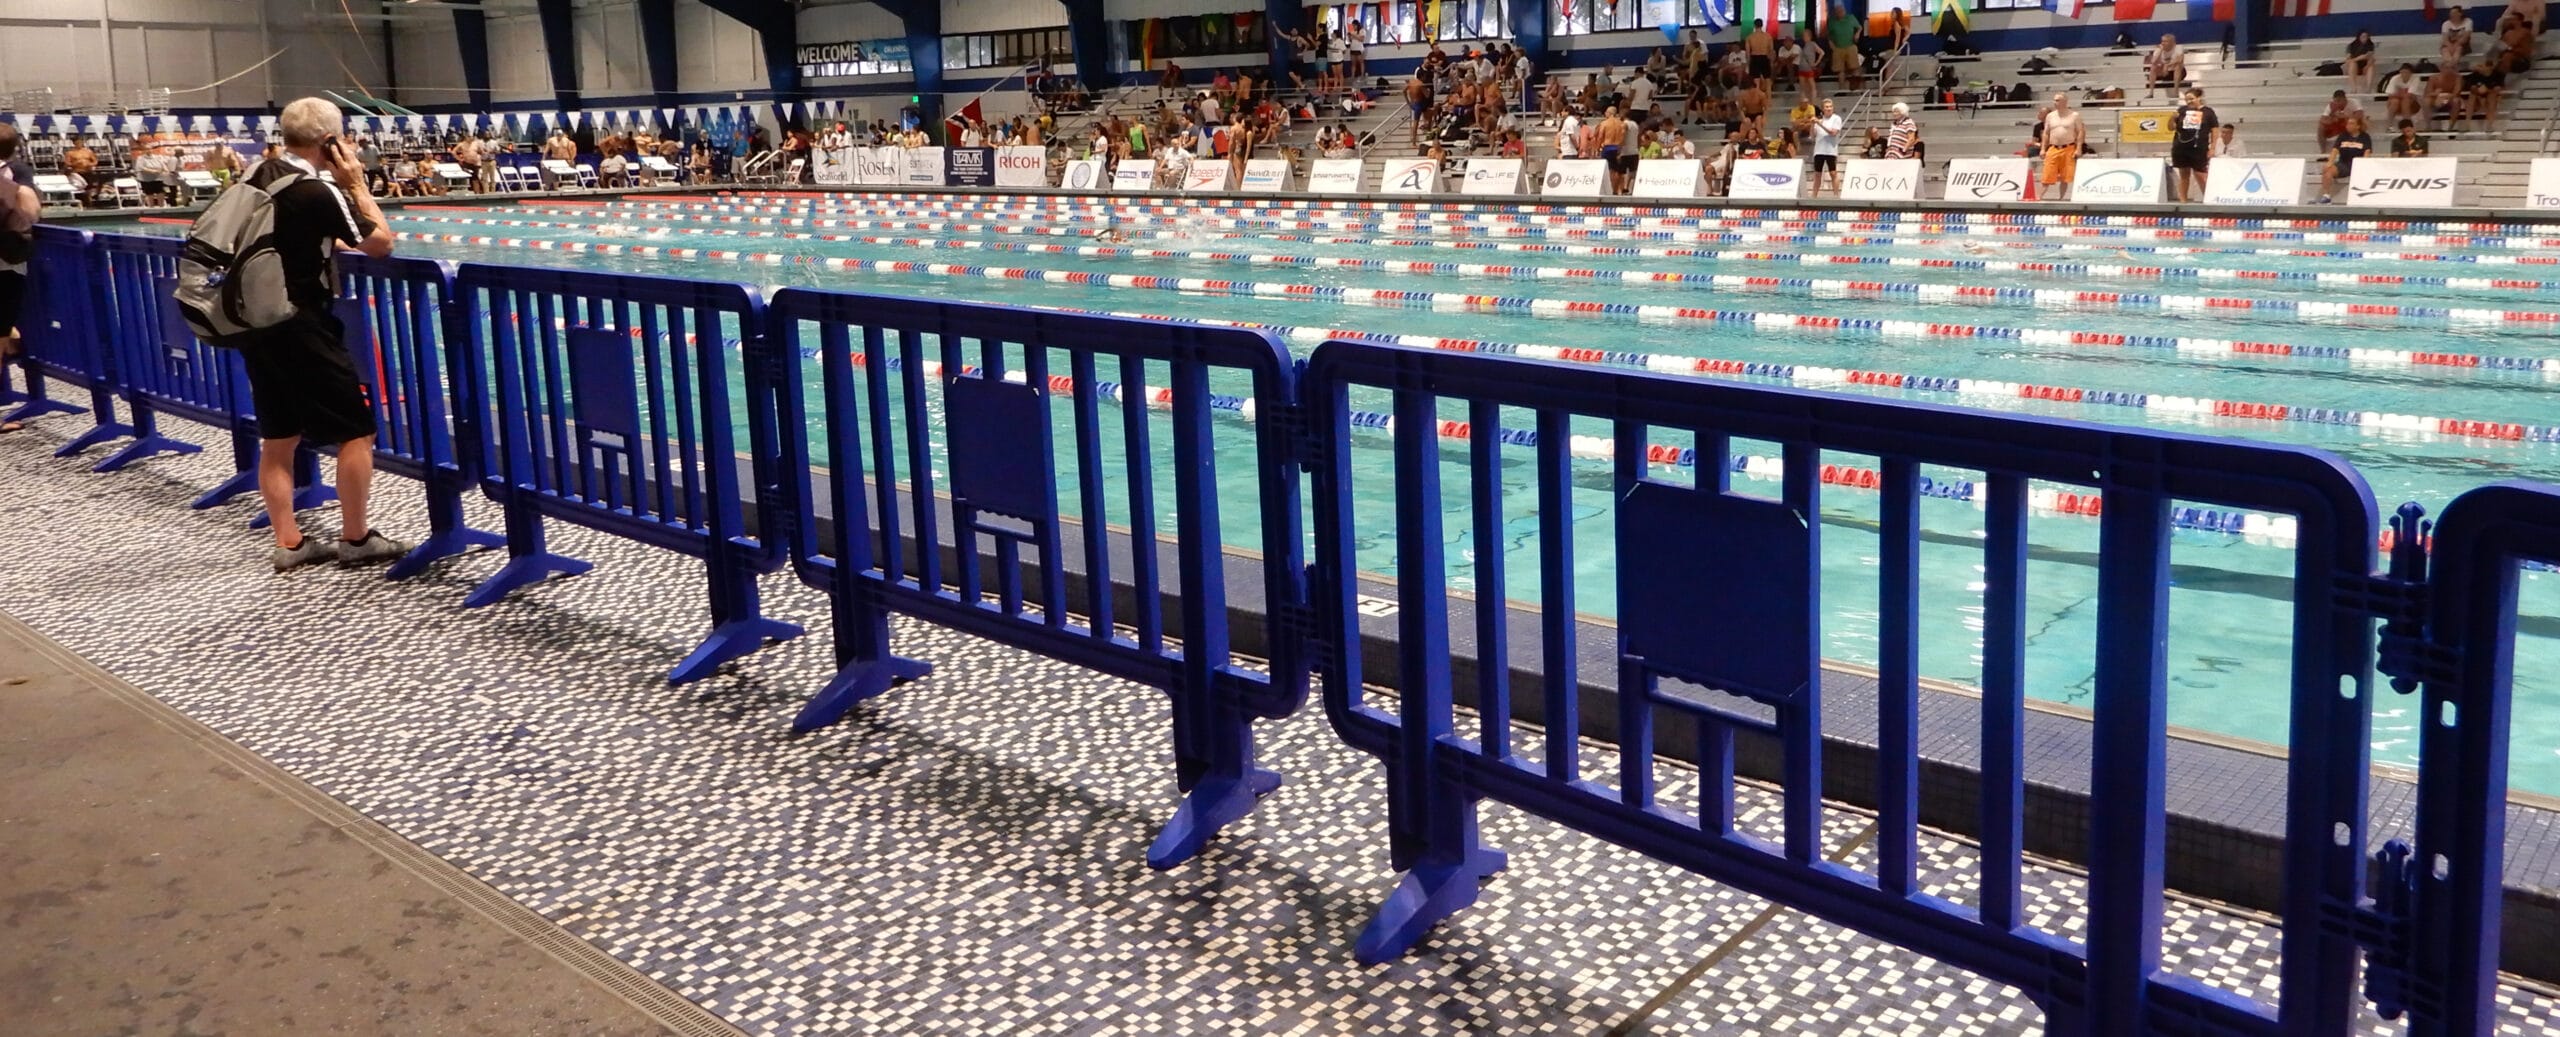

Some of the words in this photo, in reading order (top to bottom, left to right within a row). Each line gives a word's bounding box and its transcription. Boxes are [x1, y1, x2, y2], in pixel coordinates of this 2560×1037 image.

[797, 44, 859, 64] WELCOME
[1000, 156, 1040, 168] RICOH
[1564, 175, 1597, 186] Hy-Tek
[1952, 172, 2003, 186] INFINIT
[2370, 178, 2450, 190] FINIS
